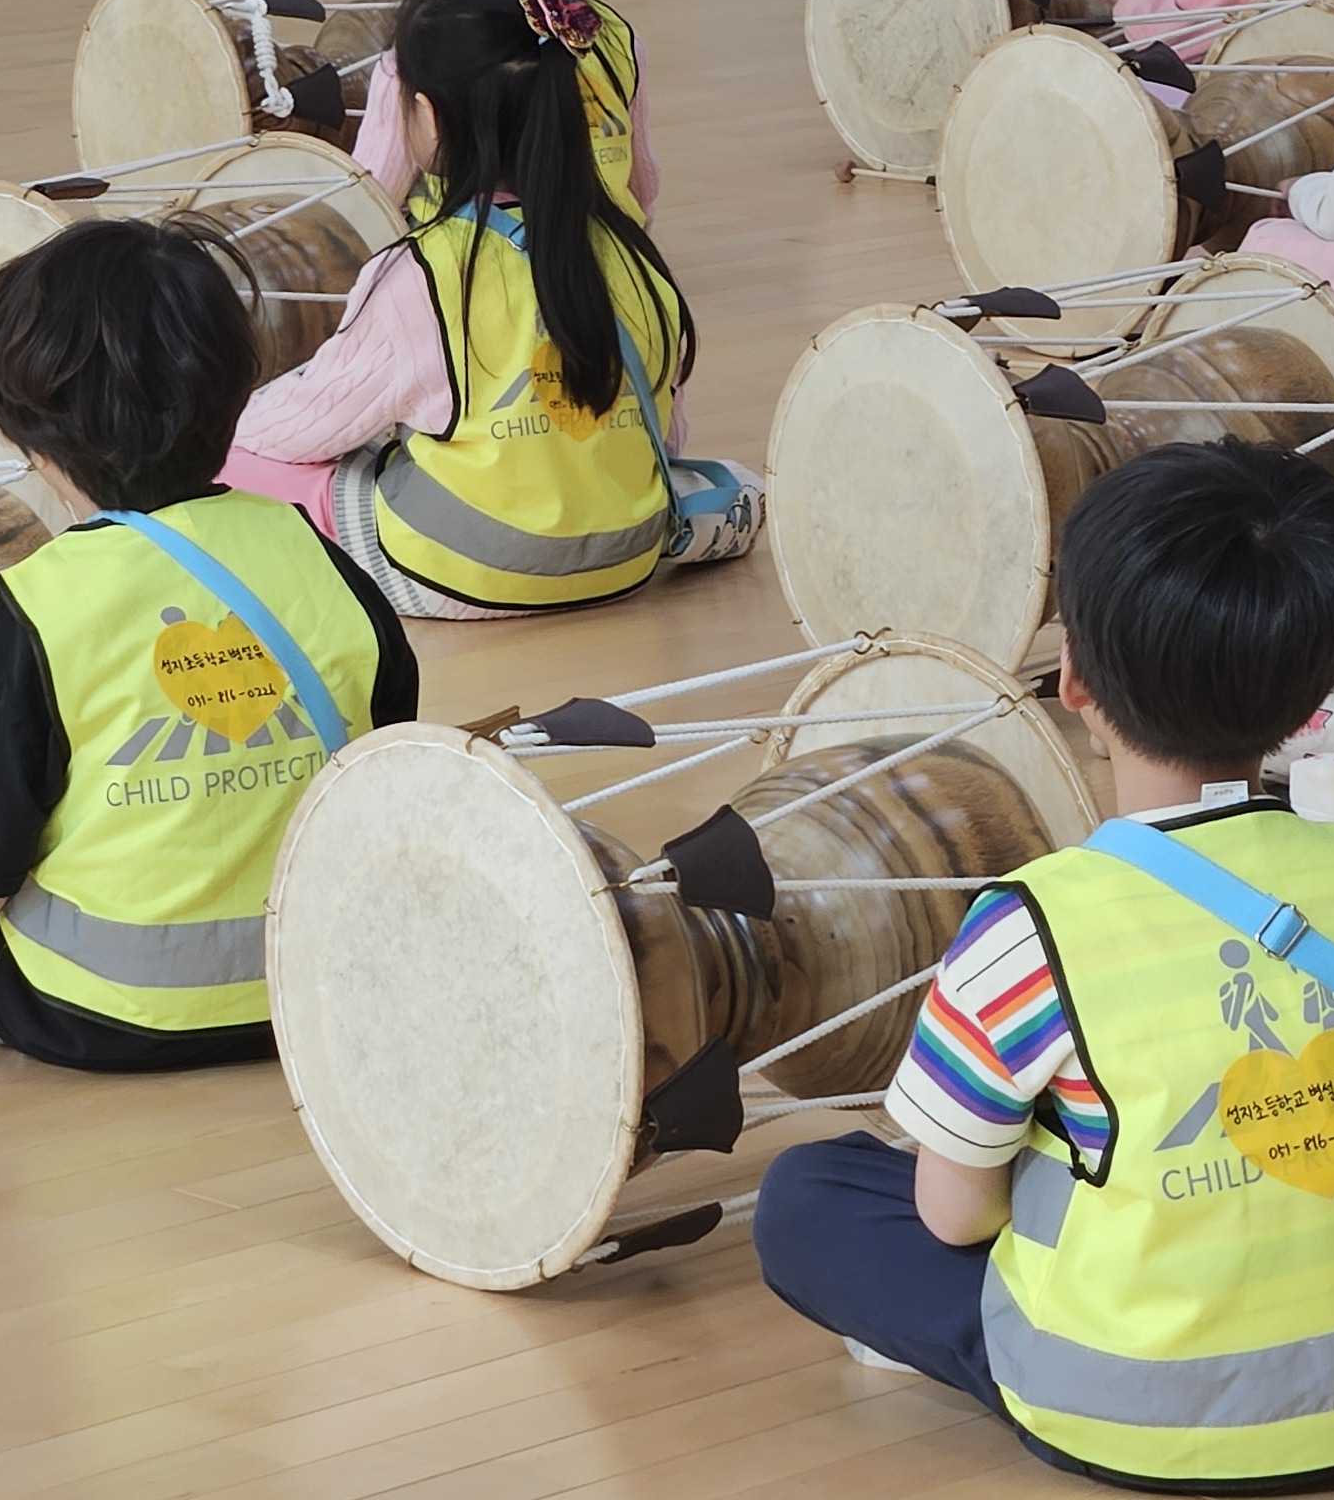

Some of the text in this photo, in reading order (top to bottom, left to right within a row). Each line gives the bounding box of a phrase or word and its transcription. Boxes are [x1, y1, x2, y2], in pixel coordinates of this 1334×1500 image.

[490, 413, 551, 440] CHILD
[160, 650, 230, 675] 성지초등학교
[105, 775, 191, 808] CHILD
[1225, 1091, 1310, 1126] 성지초등학교
[1160, 1153, 1265, 1201] CHILD
